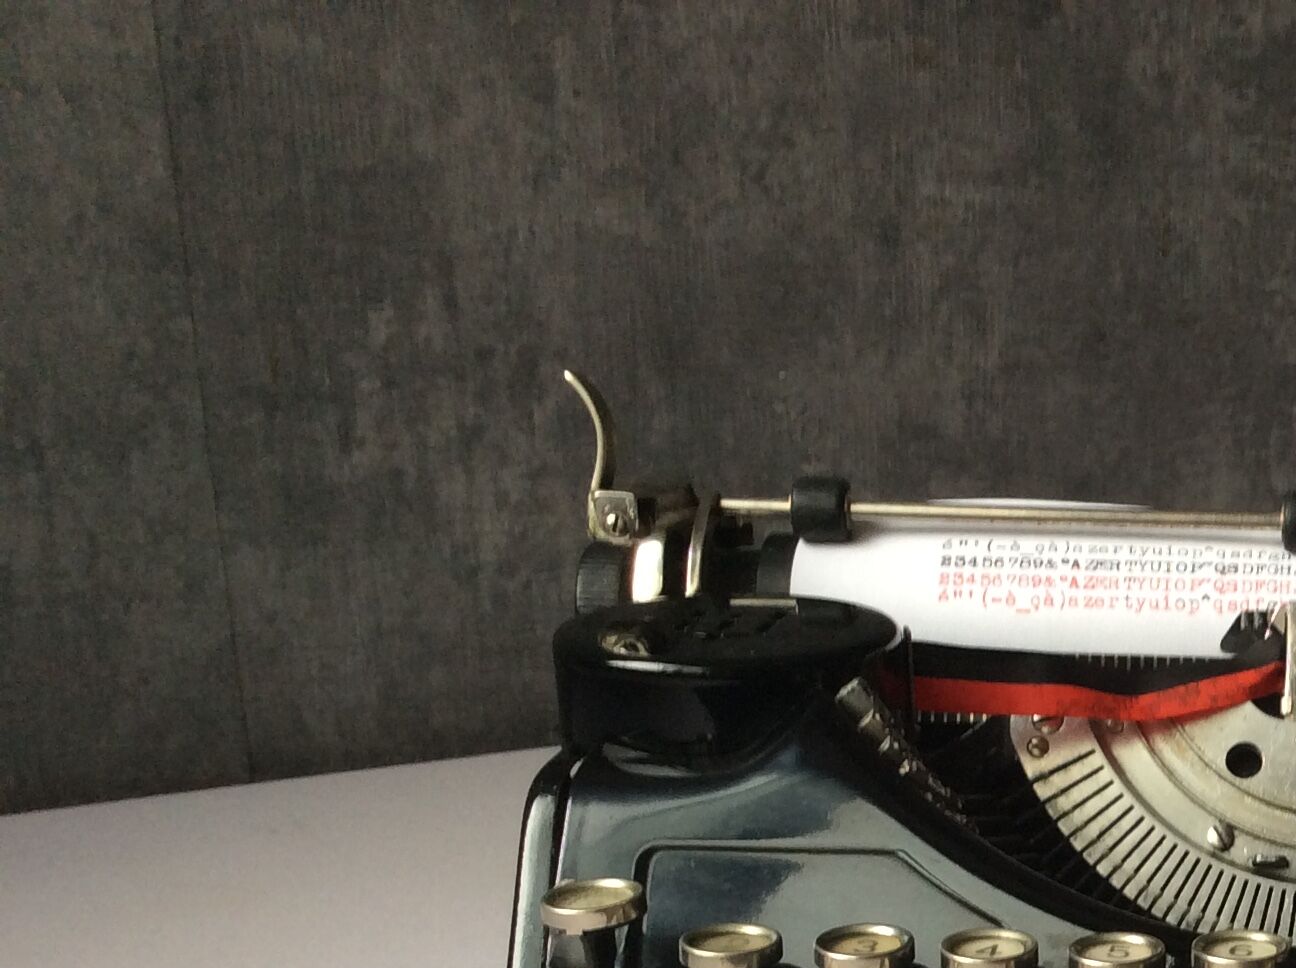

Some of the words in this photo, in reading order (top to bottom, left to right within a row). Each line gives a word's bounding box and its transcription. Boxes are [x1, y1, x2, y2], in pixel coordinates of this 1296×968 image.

[854, 939, 877, 953] 3
[976, 944, 1000, 957] 4
[1107, 945, 1129, 958] 5
[1230, 945, 1251, 957] 6
